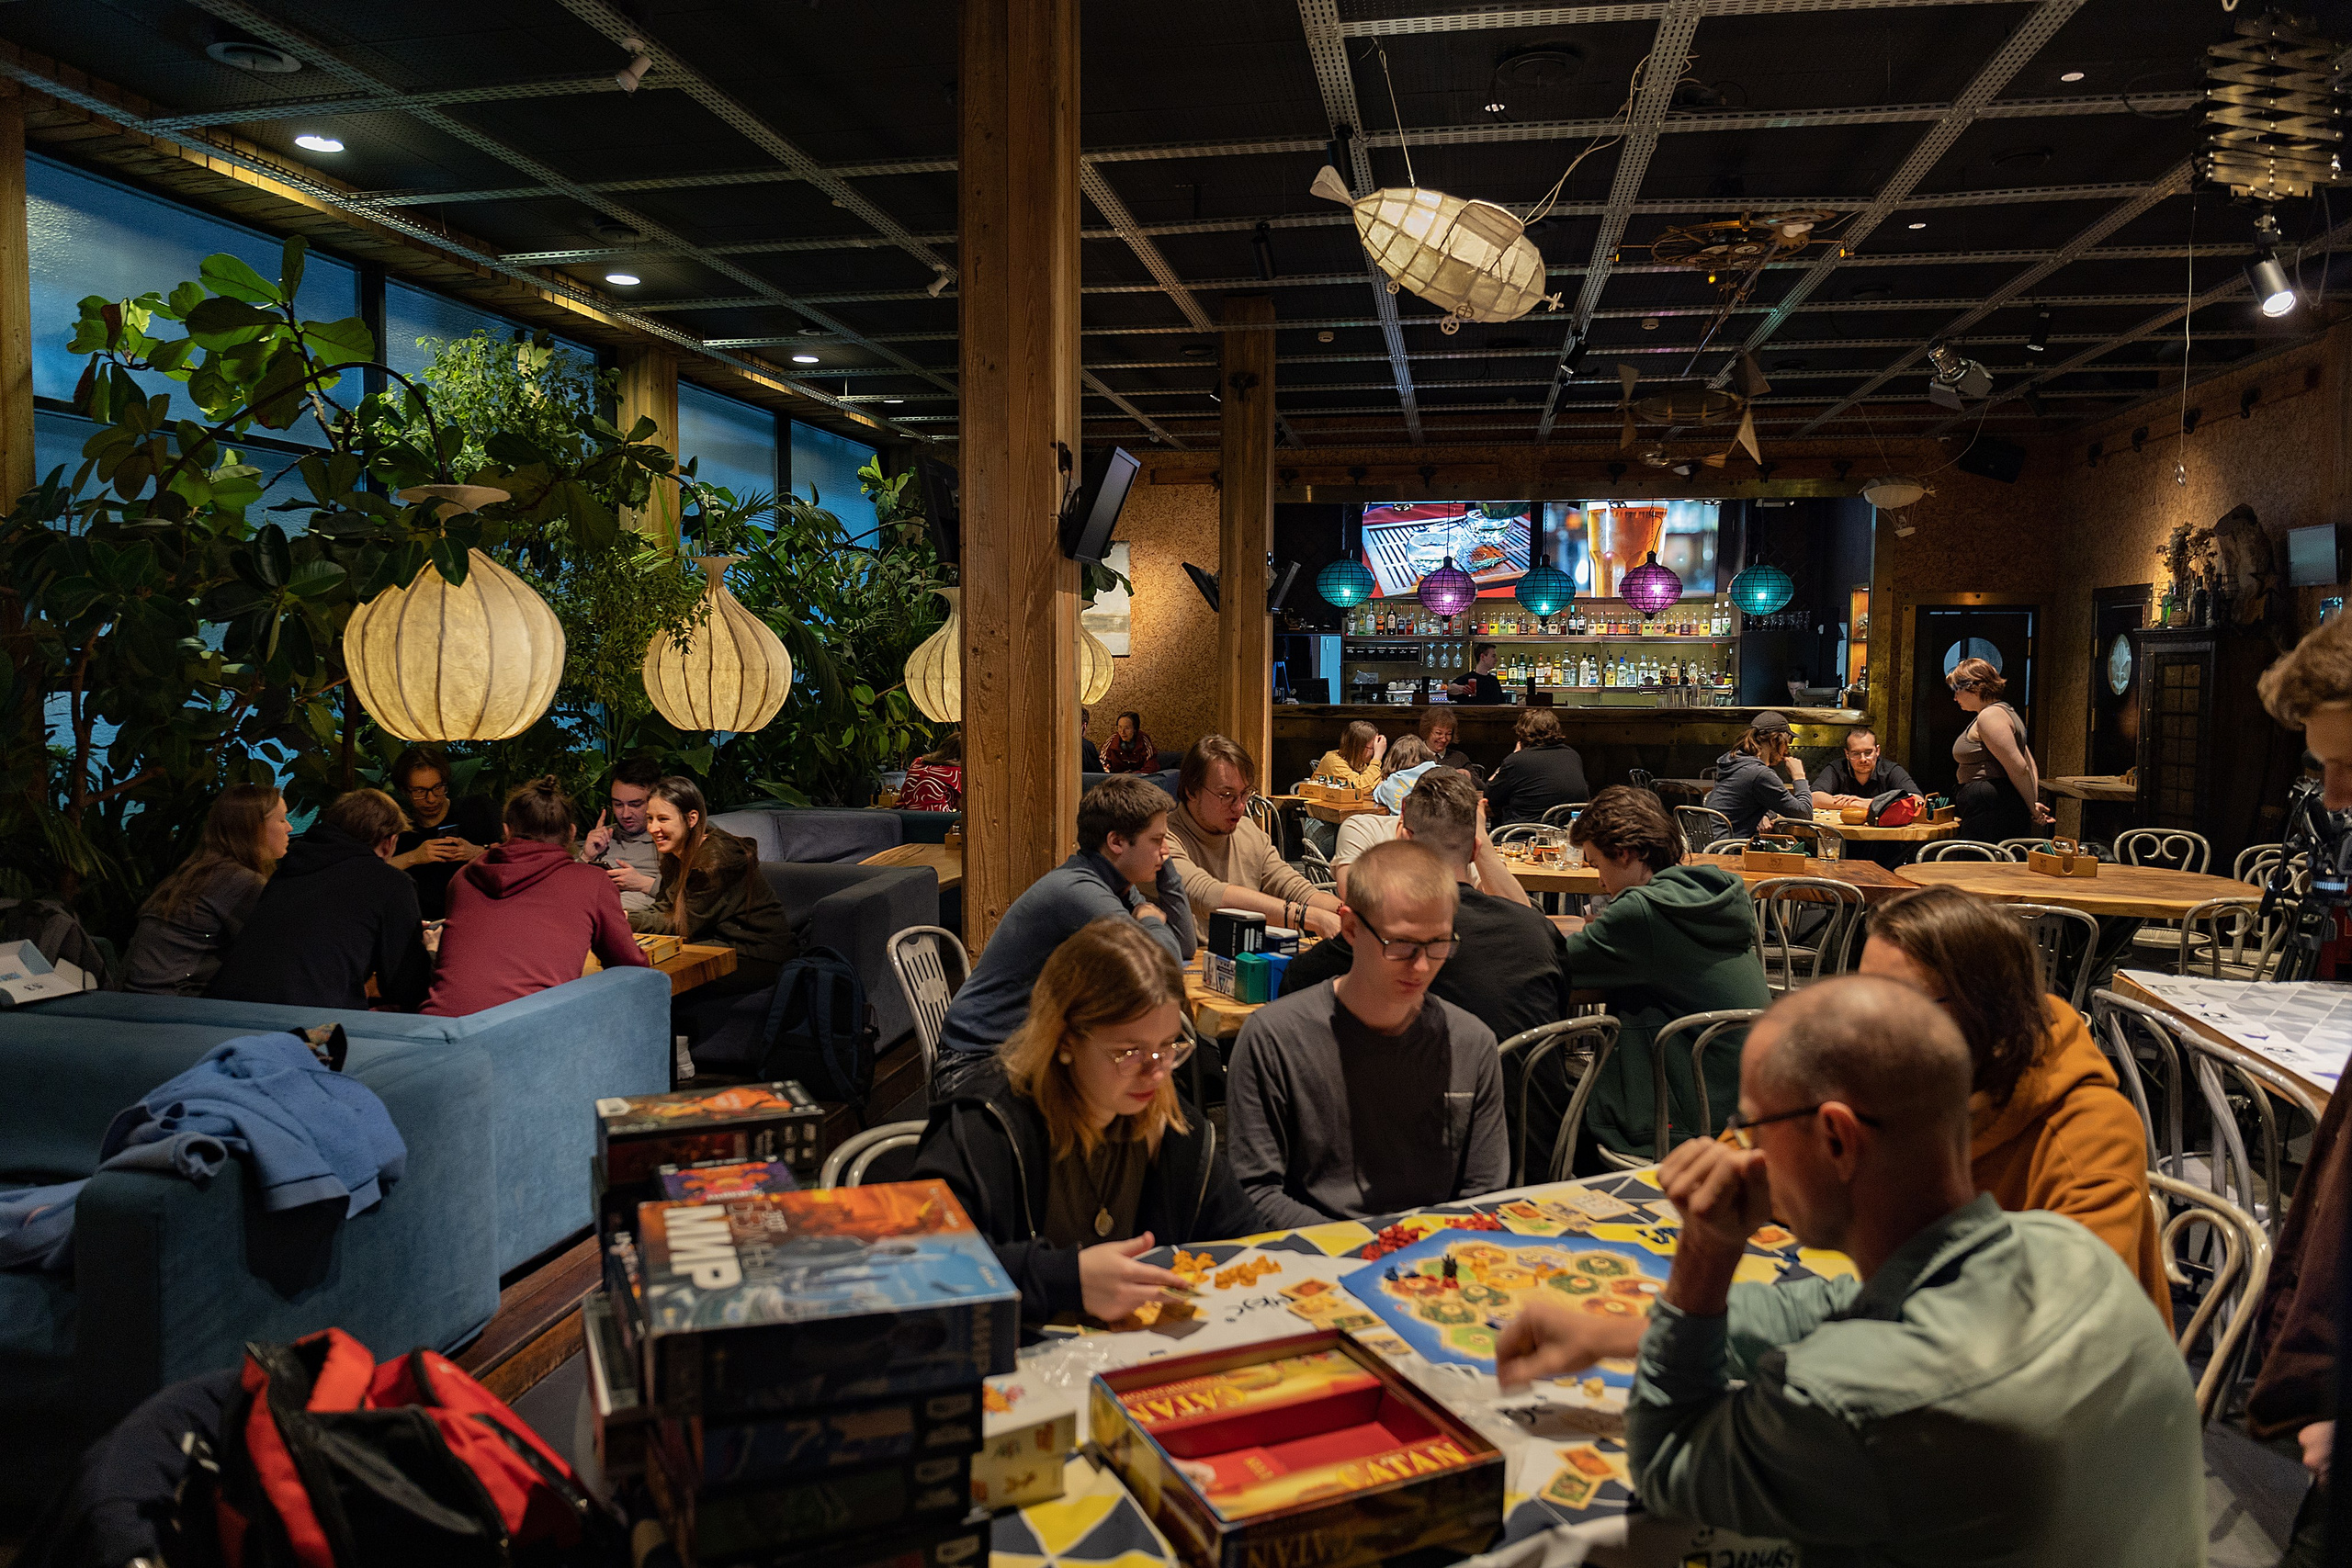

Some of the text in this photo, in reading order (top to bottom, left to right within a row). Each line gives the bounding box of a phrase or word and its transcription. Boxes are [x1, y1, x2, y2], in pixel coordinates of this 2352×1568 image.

[663, 1203, 742, 1291] МИР
[1126, 1383, 1249, 1425] CATAN
[1336, 1440, 1467, 1491] CATAN
